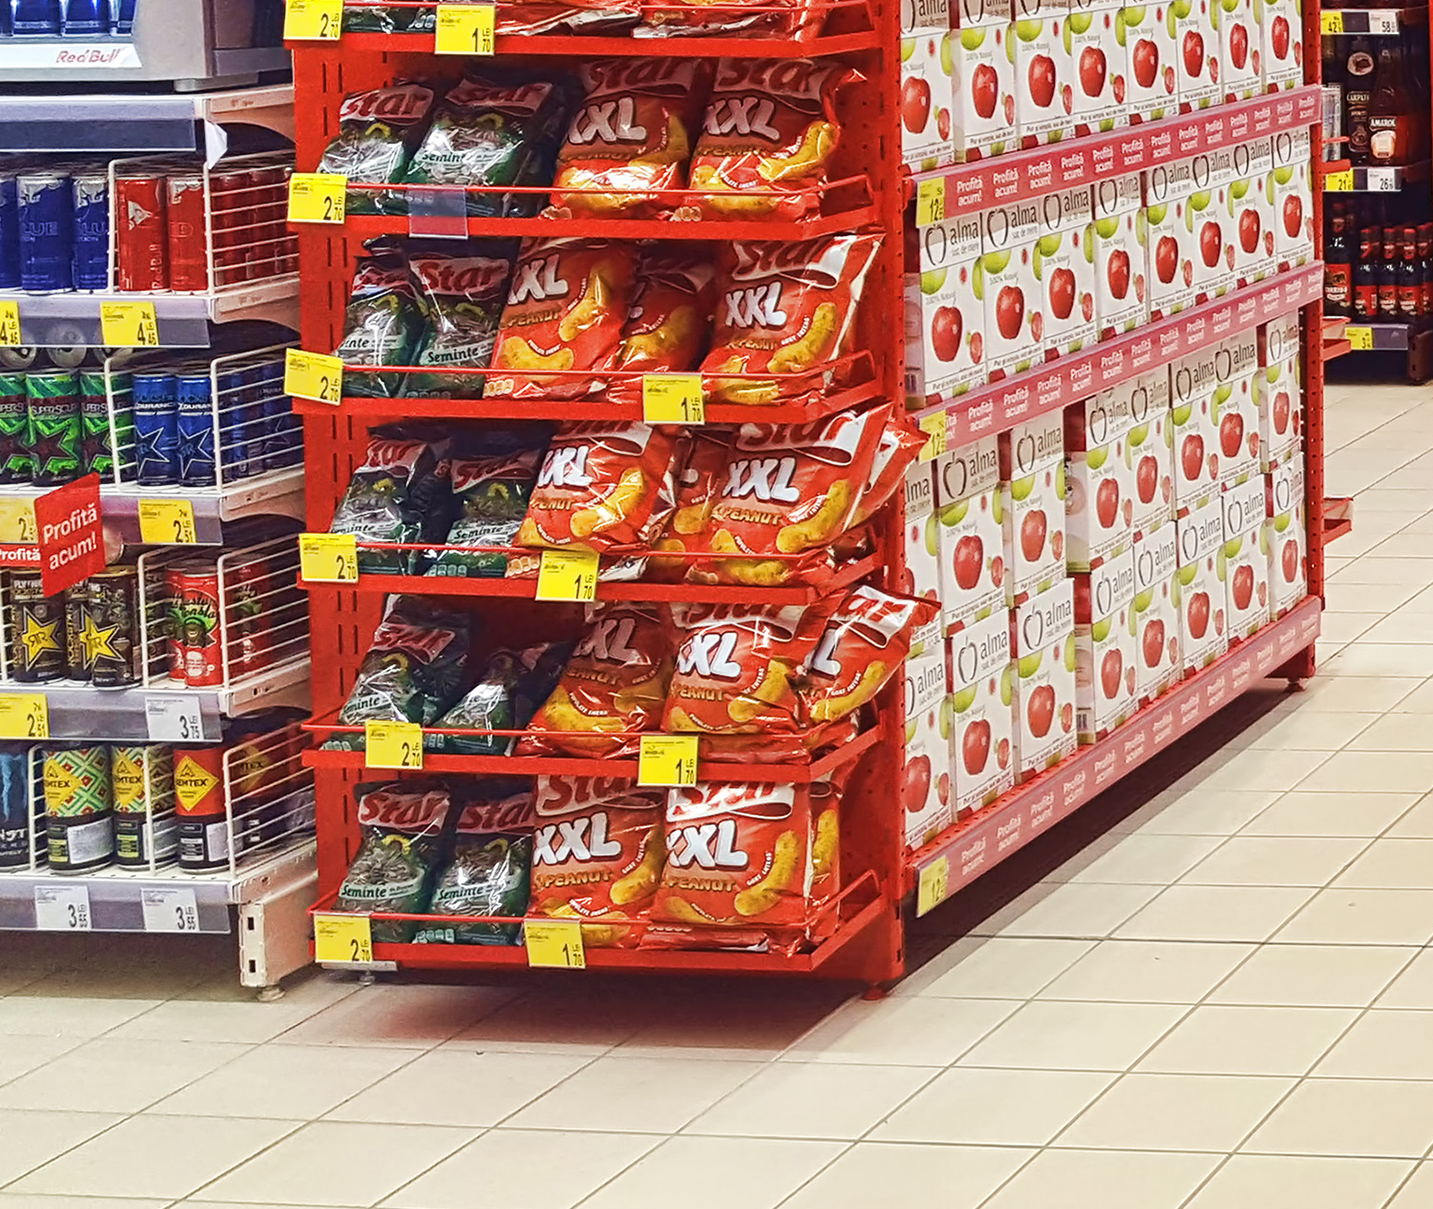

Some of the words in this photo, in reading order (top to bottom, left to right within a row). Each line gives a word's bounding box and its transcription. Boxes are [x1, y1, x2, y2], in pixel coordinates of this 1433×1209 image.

[948, 221, 979, 244] alma
[725, 289, 787, 329] XXL
[427, 345, 479, 364] Seminte
[537, 443, 592, 487] XXL
[729, 458, 800, 502] XXL
[43, 504, 97, 544] Profită
[173, 520, 182, 542] 2
[49, 532, 97, 570] acum!
[979, 629, 1007, 659] alma
[27, 714, 36, 737] 2
[179, 716, 189, 739] 3
[534, 813, 621, 864] XXL
[666, 819, 748, 869] XXL
[339, 885, 387, 900] Seminte
[68, 905, 77, 927] 3
[176, 907, 185, 930] 3
[350, 938, 360, 962] 2
[561, 942, 569, 965] 1
